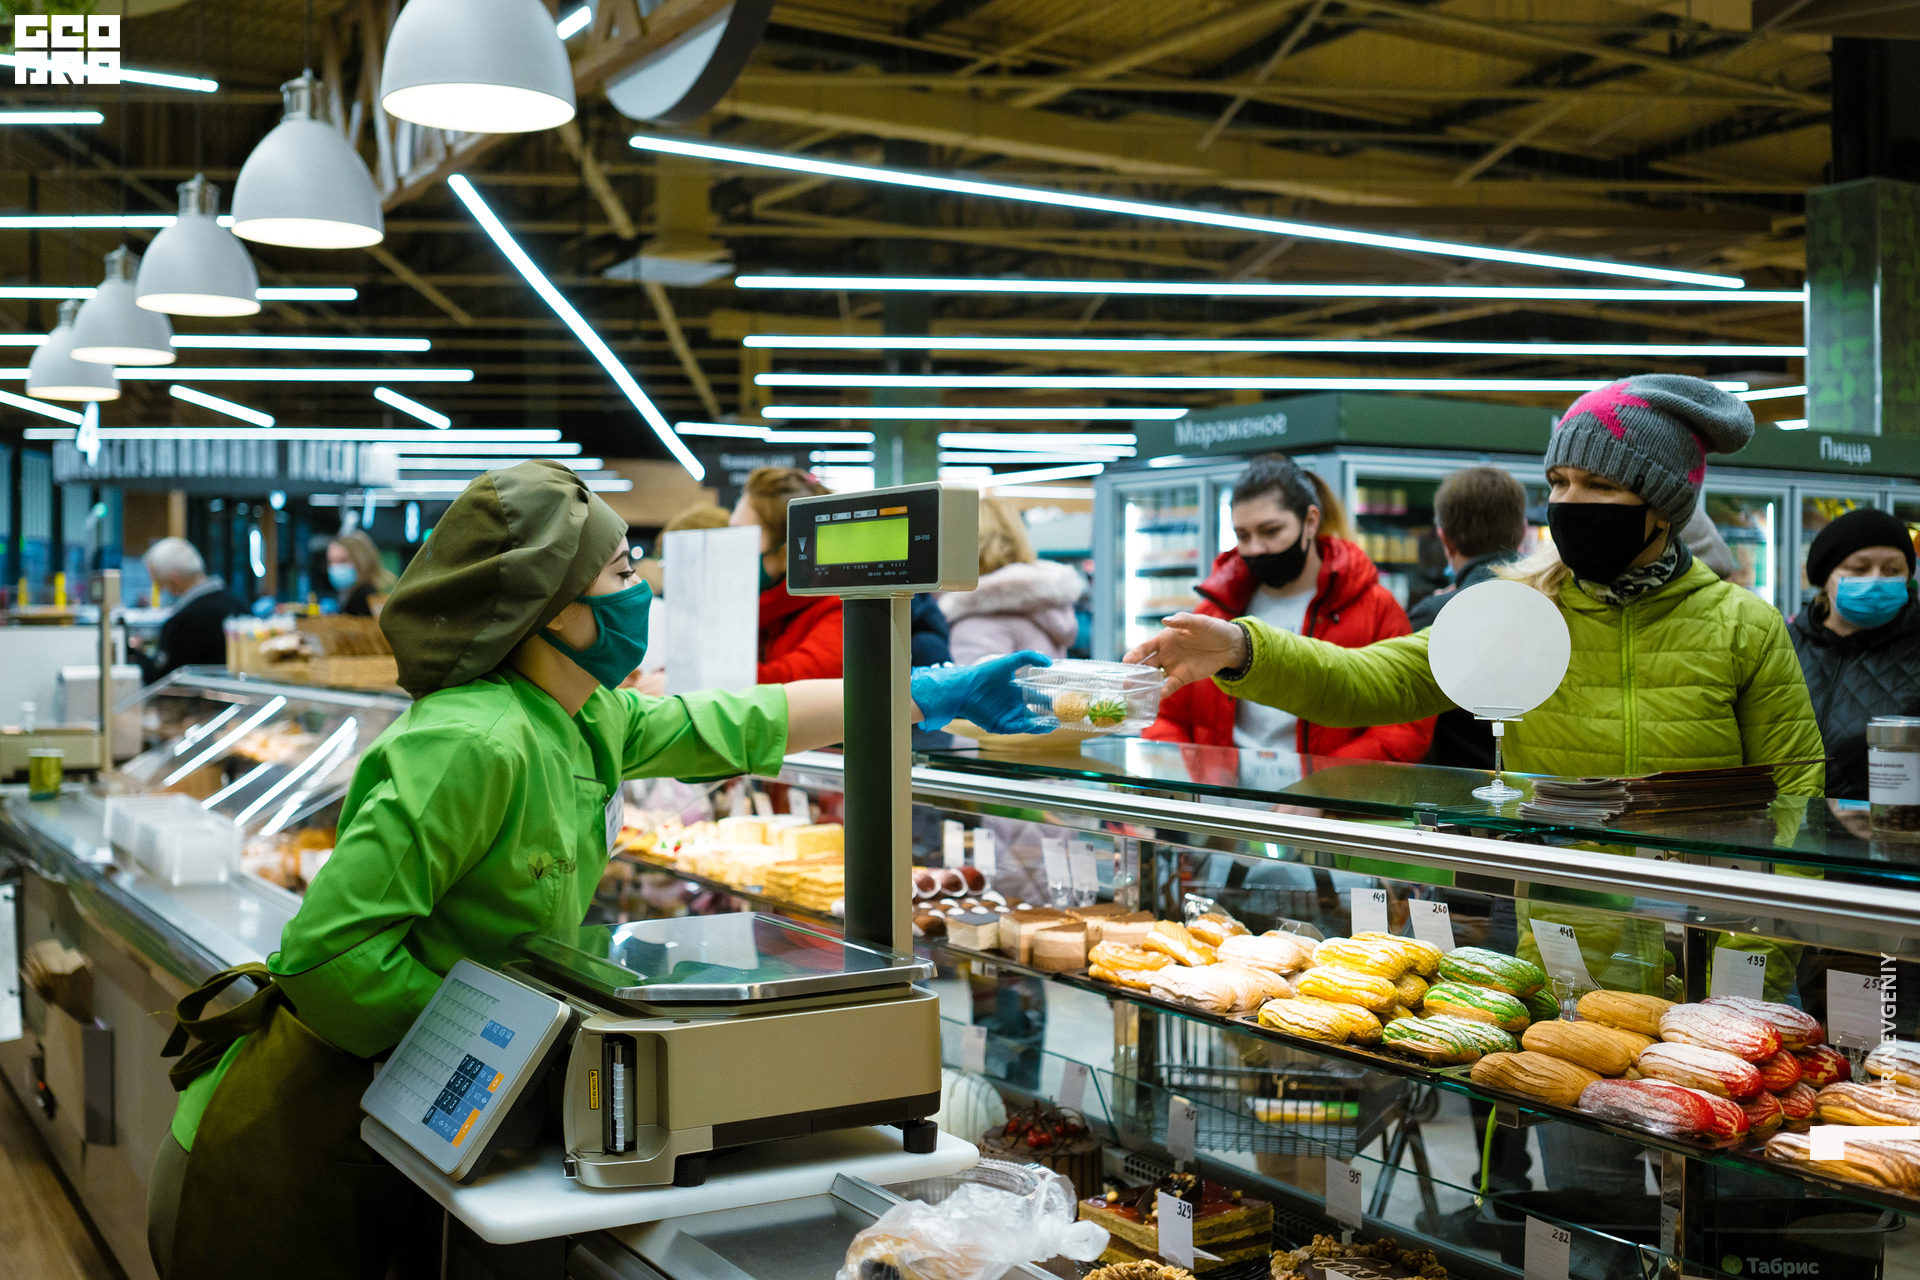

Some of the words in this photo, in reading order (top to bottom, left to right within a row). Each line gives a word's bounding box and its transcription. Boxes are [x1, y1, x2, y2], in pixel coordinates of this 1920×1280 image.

[1820, 436, 1872, 466] Пицца
[1372, 892, 1386, 903] 149
[1432, 903, 1447, 914] 260
[1559, 926, 1574, 939] 148
[1746, 955, 1765, 967] 139
[461, 1056, 469, 1066] 7
[466, 1060, 475, 1070] 8
[473, 1064, 481, 1074] 9
[450, 1074, 458, 1083] 4
[455, 1078, 463, 1087] 5
[461, 1082, 469, 1092] 6
[438, 1091, 446, 1100] 1
[443, 1095, 451, 1105] 2
[449, 1099, 458, 1109] 3
[426, 1109, 434, 1119] 0
[1349, 1170, 1362, 1184] 95
[1177, 1201, 1192, 1219] 329
[1746, 1257, 1820, 1278] Табрис
